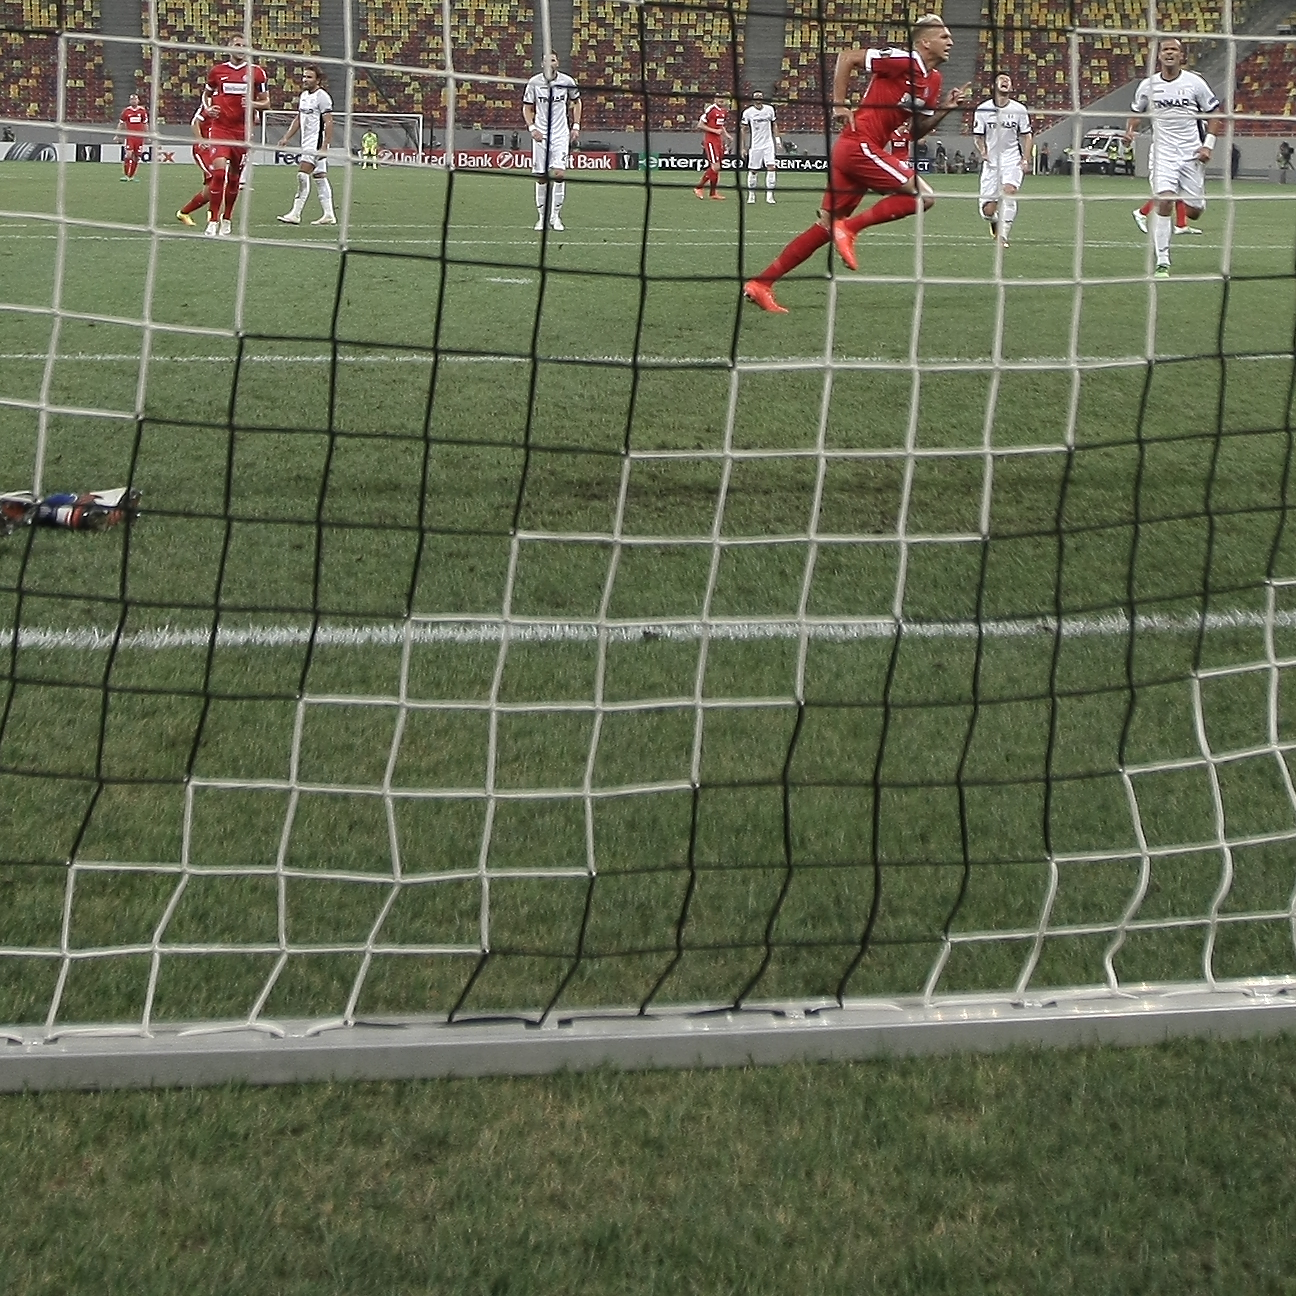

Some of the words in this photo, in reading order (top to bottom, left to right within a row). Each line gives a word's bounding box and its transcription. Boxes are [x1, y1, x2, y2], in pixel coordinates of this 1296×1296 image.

[458, 152, 492, 167] Bank
[577, 155, 611, 170] Bank
[773, 159, 828, 170] RENT-A-CA
